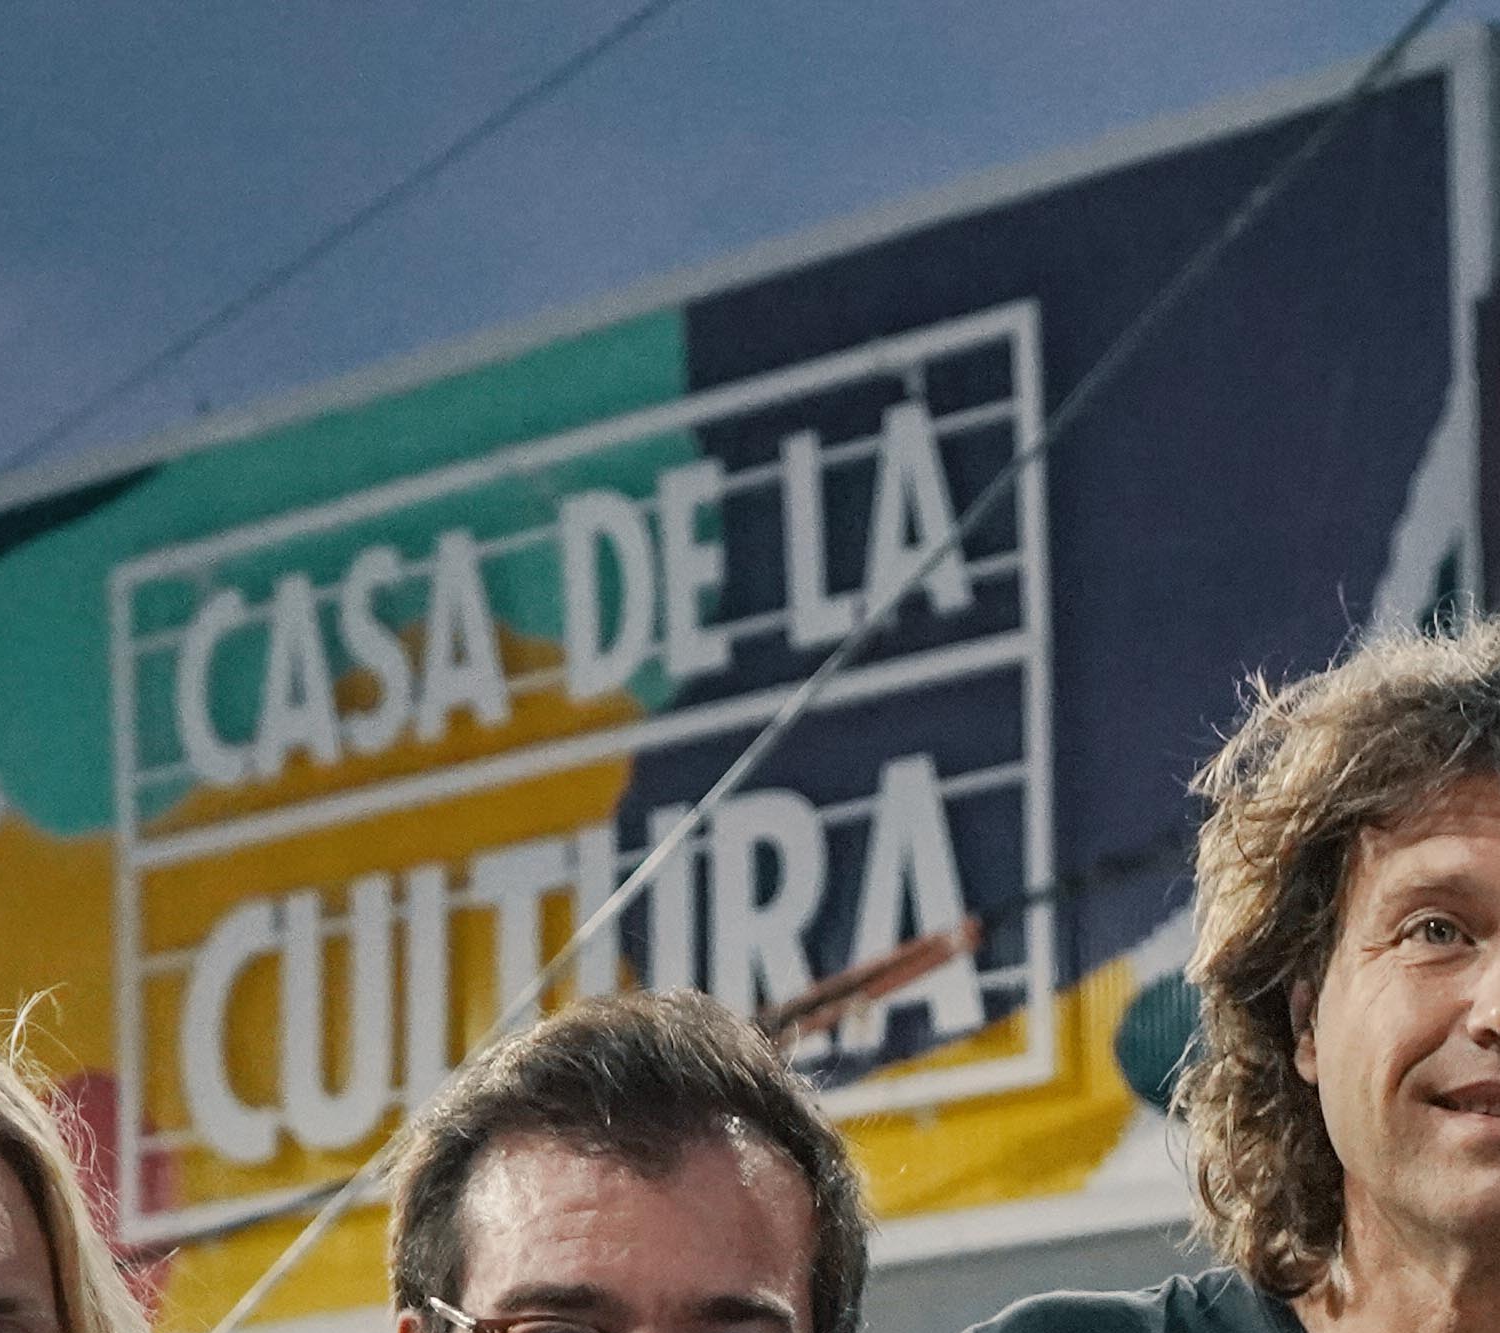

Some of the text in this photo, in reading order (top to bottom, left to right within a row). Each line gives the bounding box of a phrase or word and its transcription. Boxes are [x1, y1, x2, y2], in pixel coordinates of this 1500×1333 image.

[179, 404, 973, 784] CASA DE LA
[183, 755, 985, 1164] CULTURA
